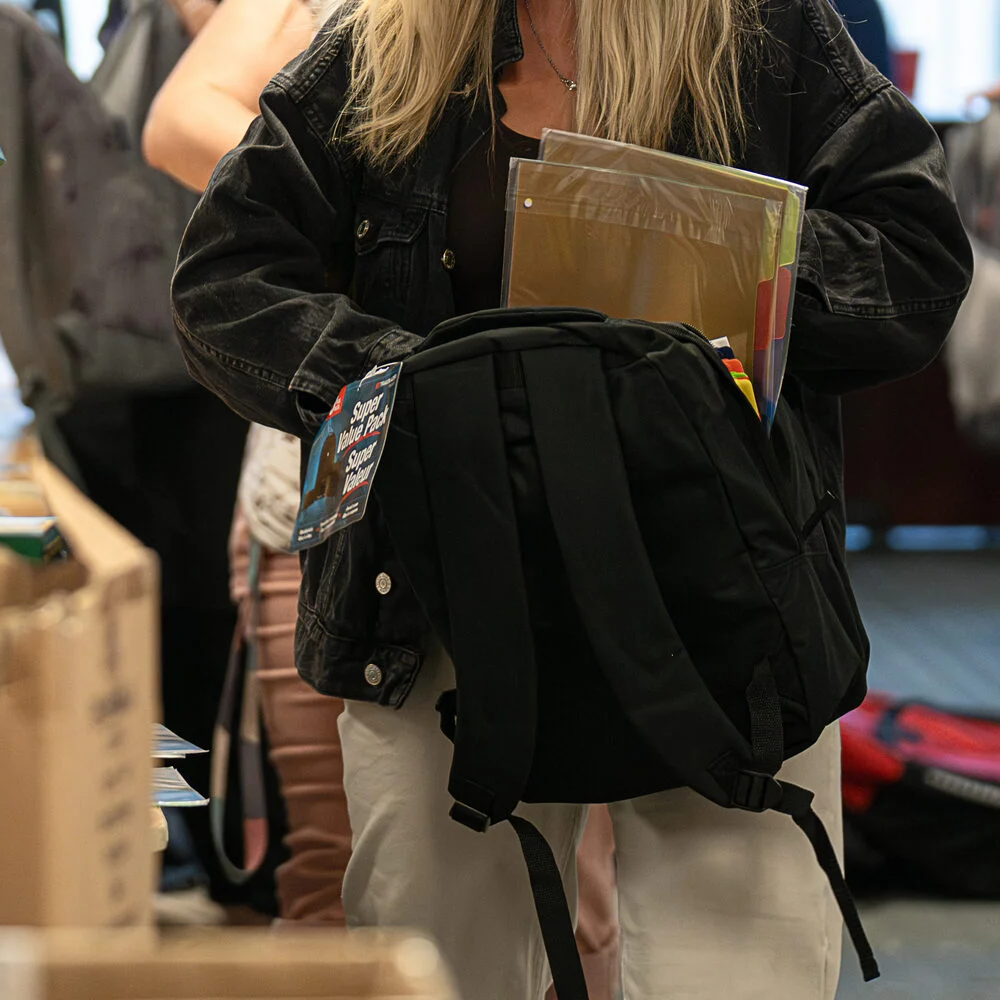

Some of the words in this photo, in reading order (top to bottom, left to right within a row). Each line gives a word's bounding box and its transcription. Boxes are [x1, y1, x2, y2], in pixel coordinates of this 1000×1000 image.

[350, 392, 384, 425] Super
[337, 423, 364, 454] Value
[363, 404, 389, 437] Pack
[345, 440, 378, 473] Super
[342, 461, 375, 496] Valeur
